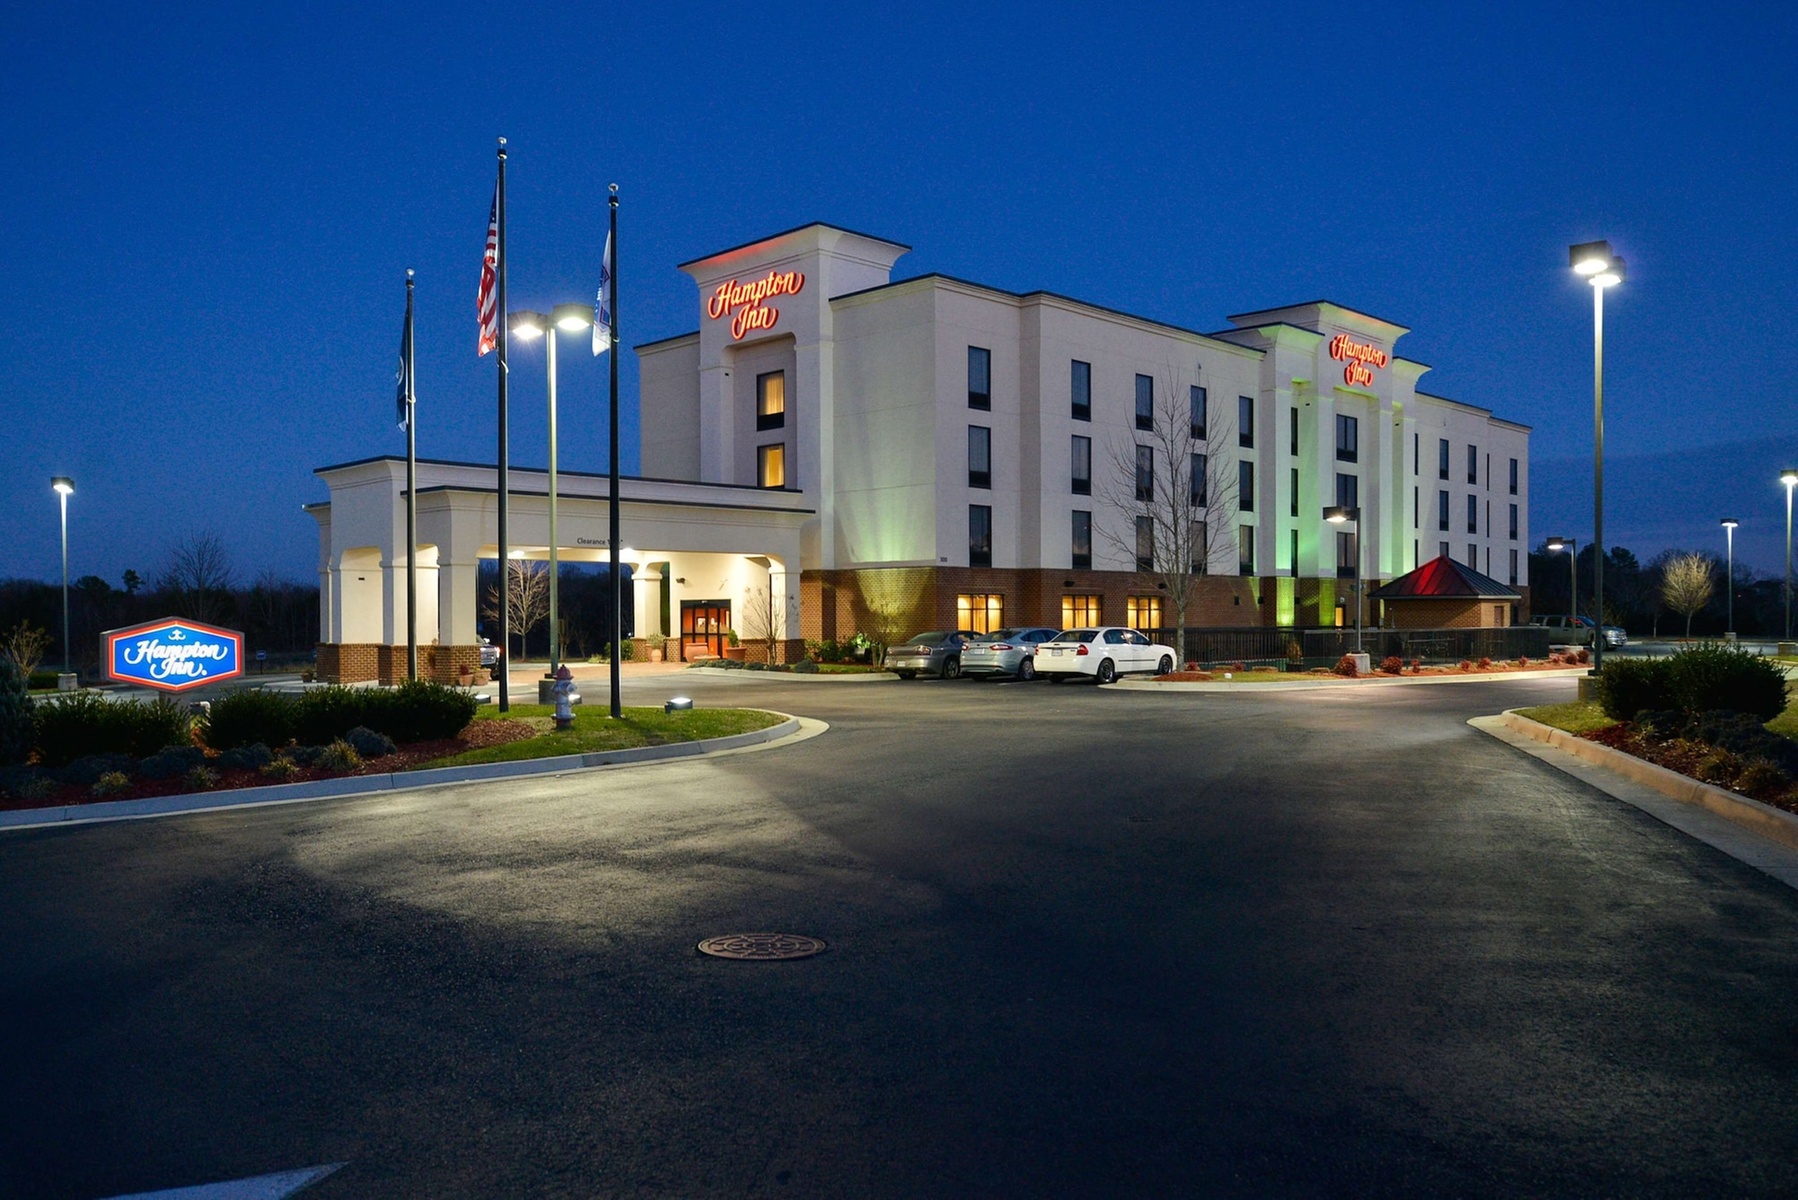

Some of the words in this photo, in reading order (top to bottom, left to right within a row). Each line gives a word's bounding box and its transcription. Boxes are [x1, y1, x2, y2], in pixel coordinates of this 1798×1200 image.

[708, 271, 805, 319] Hampton
[732, 303, 778, 340] Inn
[1329, 333, 1388, 368] Hampton
[1344, 360, 1374, 387] Inn
[576, 537, 606, 545] Clearance
[124, 639, 228, 664] Hampton
